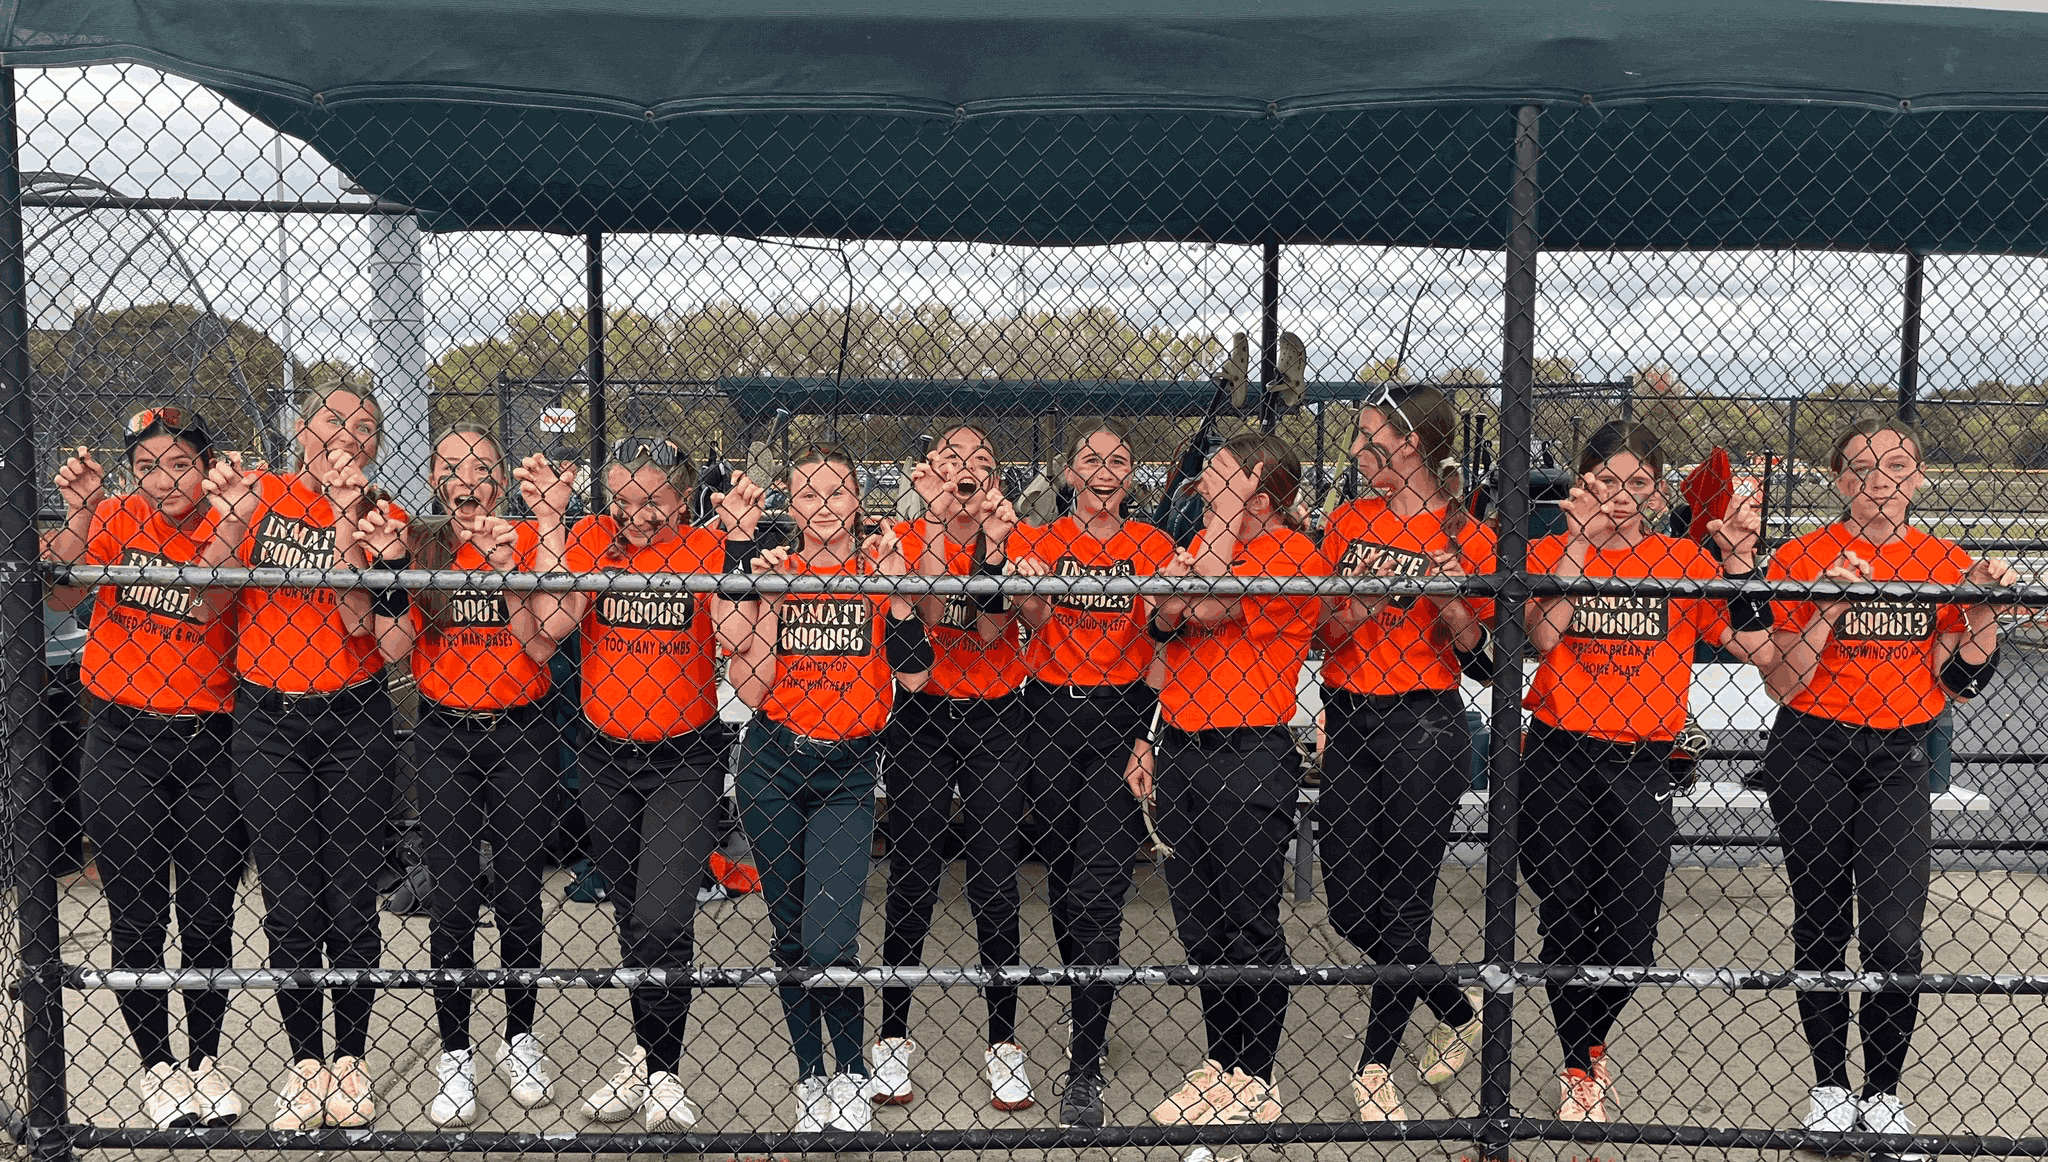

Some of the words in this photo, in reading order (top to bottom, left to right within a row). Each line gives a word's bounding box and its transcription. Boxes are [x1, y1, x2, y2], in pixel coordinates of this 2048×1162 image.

[264, 515, 335, 551] INMAT
[780, 603, 867, 626] INMATE
[1844, 611, 1929, 637] 000013
[111, 611, 138, 631] ANTED
[175, 628, 182, 641] &
[486, 632, 513, 648] BASES
[605, 637, 624, 653] TOO
[627, 639, 656, 655] MANY
[659, 640, 691, 656] BOMBS
[781, 626, 865, 652] 000066
[1571, 642, 1606, 655] PRISON
[1609, 643, 1640, 657] BREAK
[1832, 645, 1887, 660] THROWING
[1888, 646, 1908, 660] TOO
[791, 660, 828, 673] WANTED
[830, 661, 848, 673] FOR
[1582, 662, 1609, 675] HOME
[1612, 664, 1640, 677] PLATE
